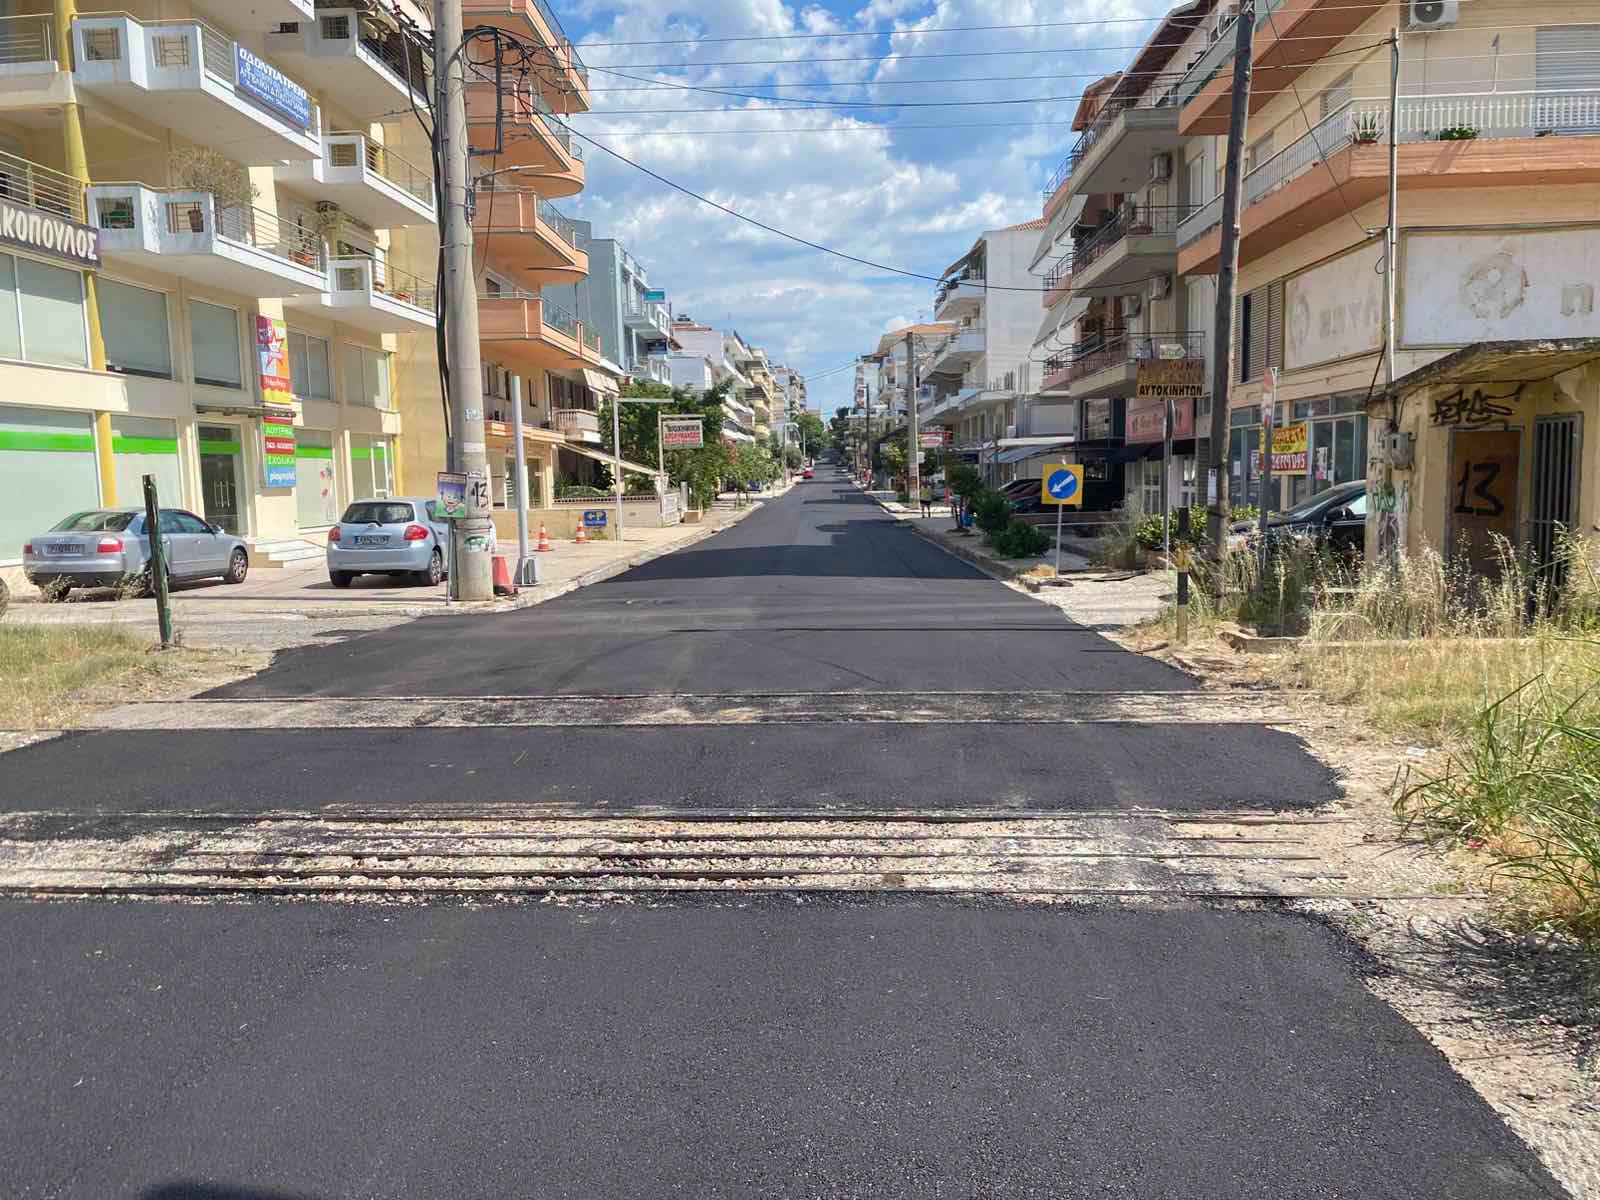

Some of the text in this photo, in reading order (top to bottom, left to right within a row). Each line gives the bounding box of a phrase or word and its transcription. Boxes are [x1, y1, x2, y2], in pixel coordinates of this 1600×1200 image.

[0, 205, 98, 260] ΚΟΠΟΥΛΟΣ
[1139, 384, 1203, 397] ΑΥΤΟΚΙΝΗΤΩΝ
[1455, 461, 1505, 517] 13
